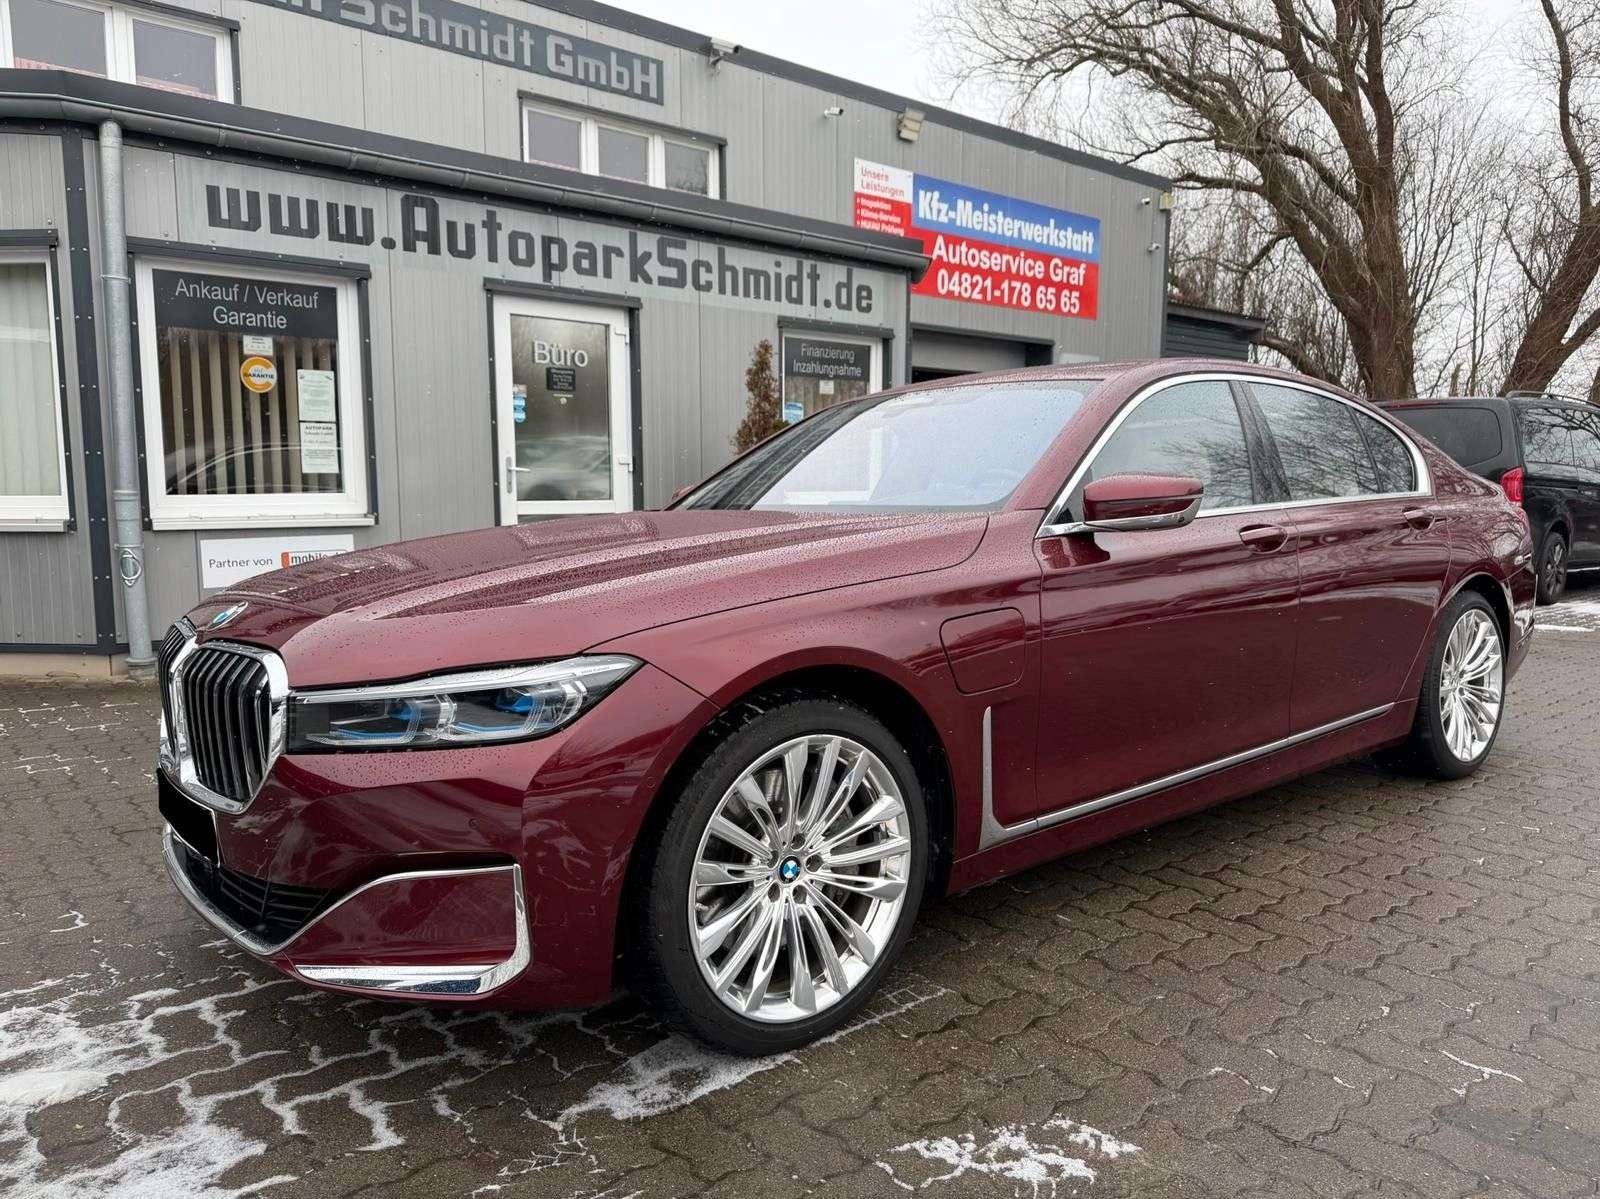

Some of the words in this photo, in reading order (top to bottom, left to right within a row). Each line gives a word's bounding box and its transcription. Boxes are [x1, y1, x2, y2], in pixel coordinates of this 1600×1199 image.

[340, 0, 535, 67] Schmidt
[546, 33, 658, 100] GmbH
[861, 166, 889, 182] Unsere
[861, 180, 904, 197] Leistungen
[918, 189, 1095, 254] Kfz-Meisterwerkstatt
[205, 184, 873, 314] www.AutoparkSchmidt.de
[932, 235, 1045, 279] Autoservice
[1050, 257, 1087, 286] Graf
[175, 278, 239, 301] Ankauf
[243, 284, 249, 303] /
[254, 286, 319, 309] Verkauf
[937, 268, 1031, 307] 04821-178
[1036, 285, 1056, 311] 65
[1060, 289, 1080, 314] 65
[213, 306, 288, 329] Garantie
[534, 340, 588, 367] Büro
[801, 343, 855, 363] Finanzierung
[793, 360, 862, 378] Inzahlungnahme
[209, 558, 250, 569] Partner
[253, 557, 273, 566] von
